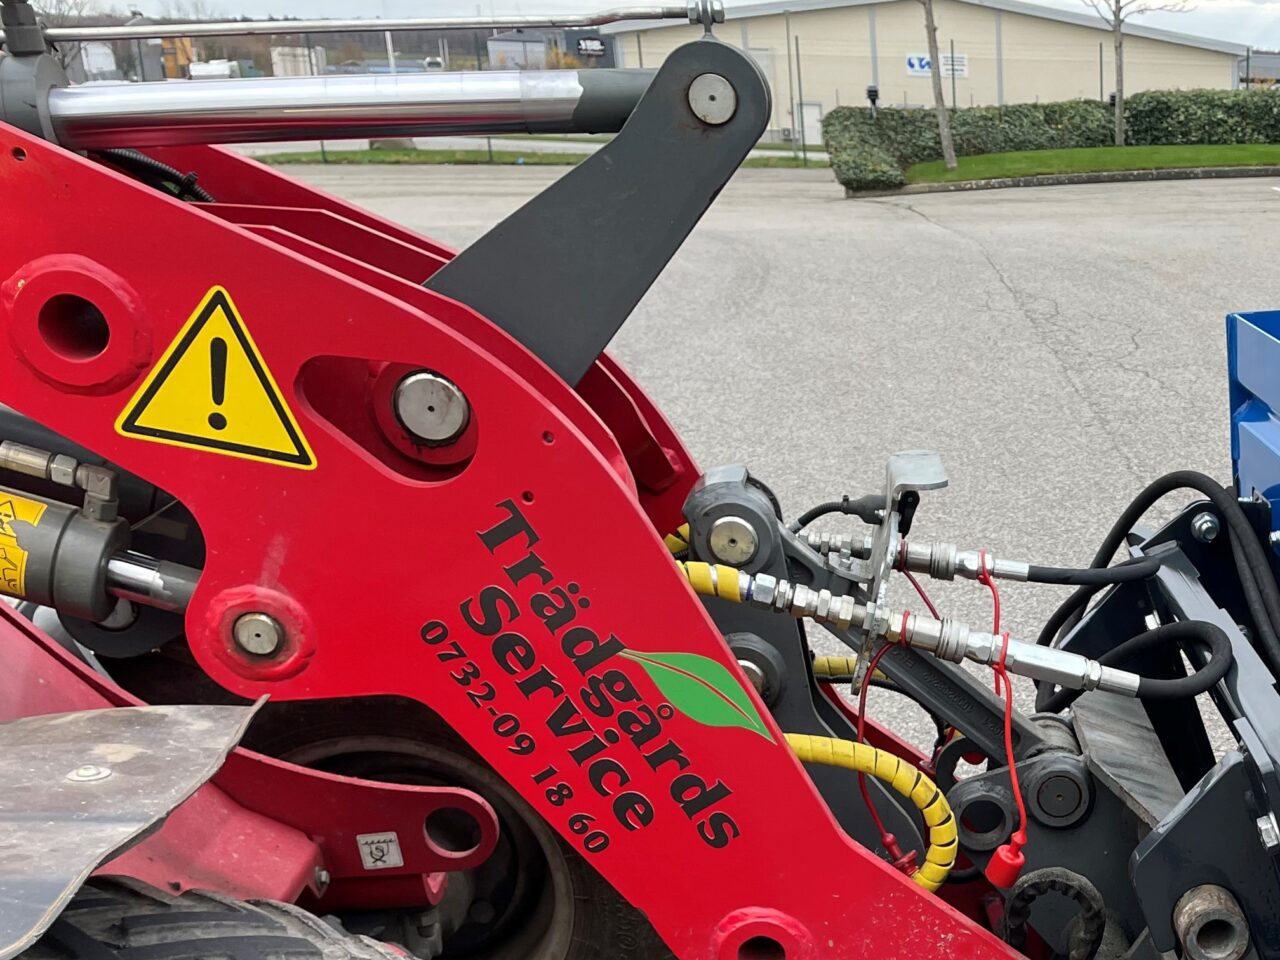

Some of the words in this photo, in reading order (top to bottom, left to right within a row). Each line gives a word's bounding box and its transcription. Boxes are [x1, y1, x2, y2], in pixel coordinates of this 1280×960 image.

[419, 619, 537, 756] 0732-09
[530, 764, 575, 807] 18
[567, 812, 611, 854] 60
[459, 584, 655, 832] Service
[475, 498, 741, 849] Trädgårds
